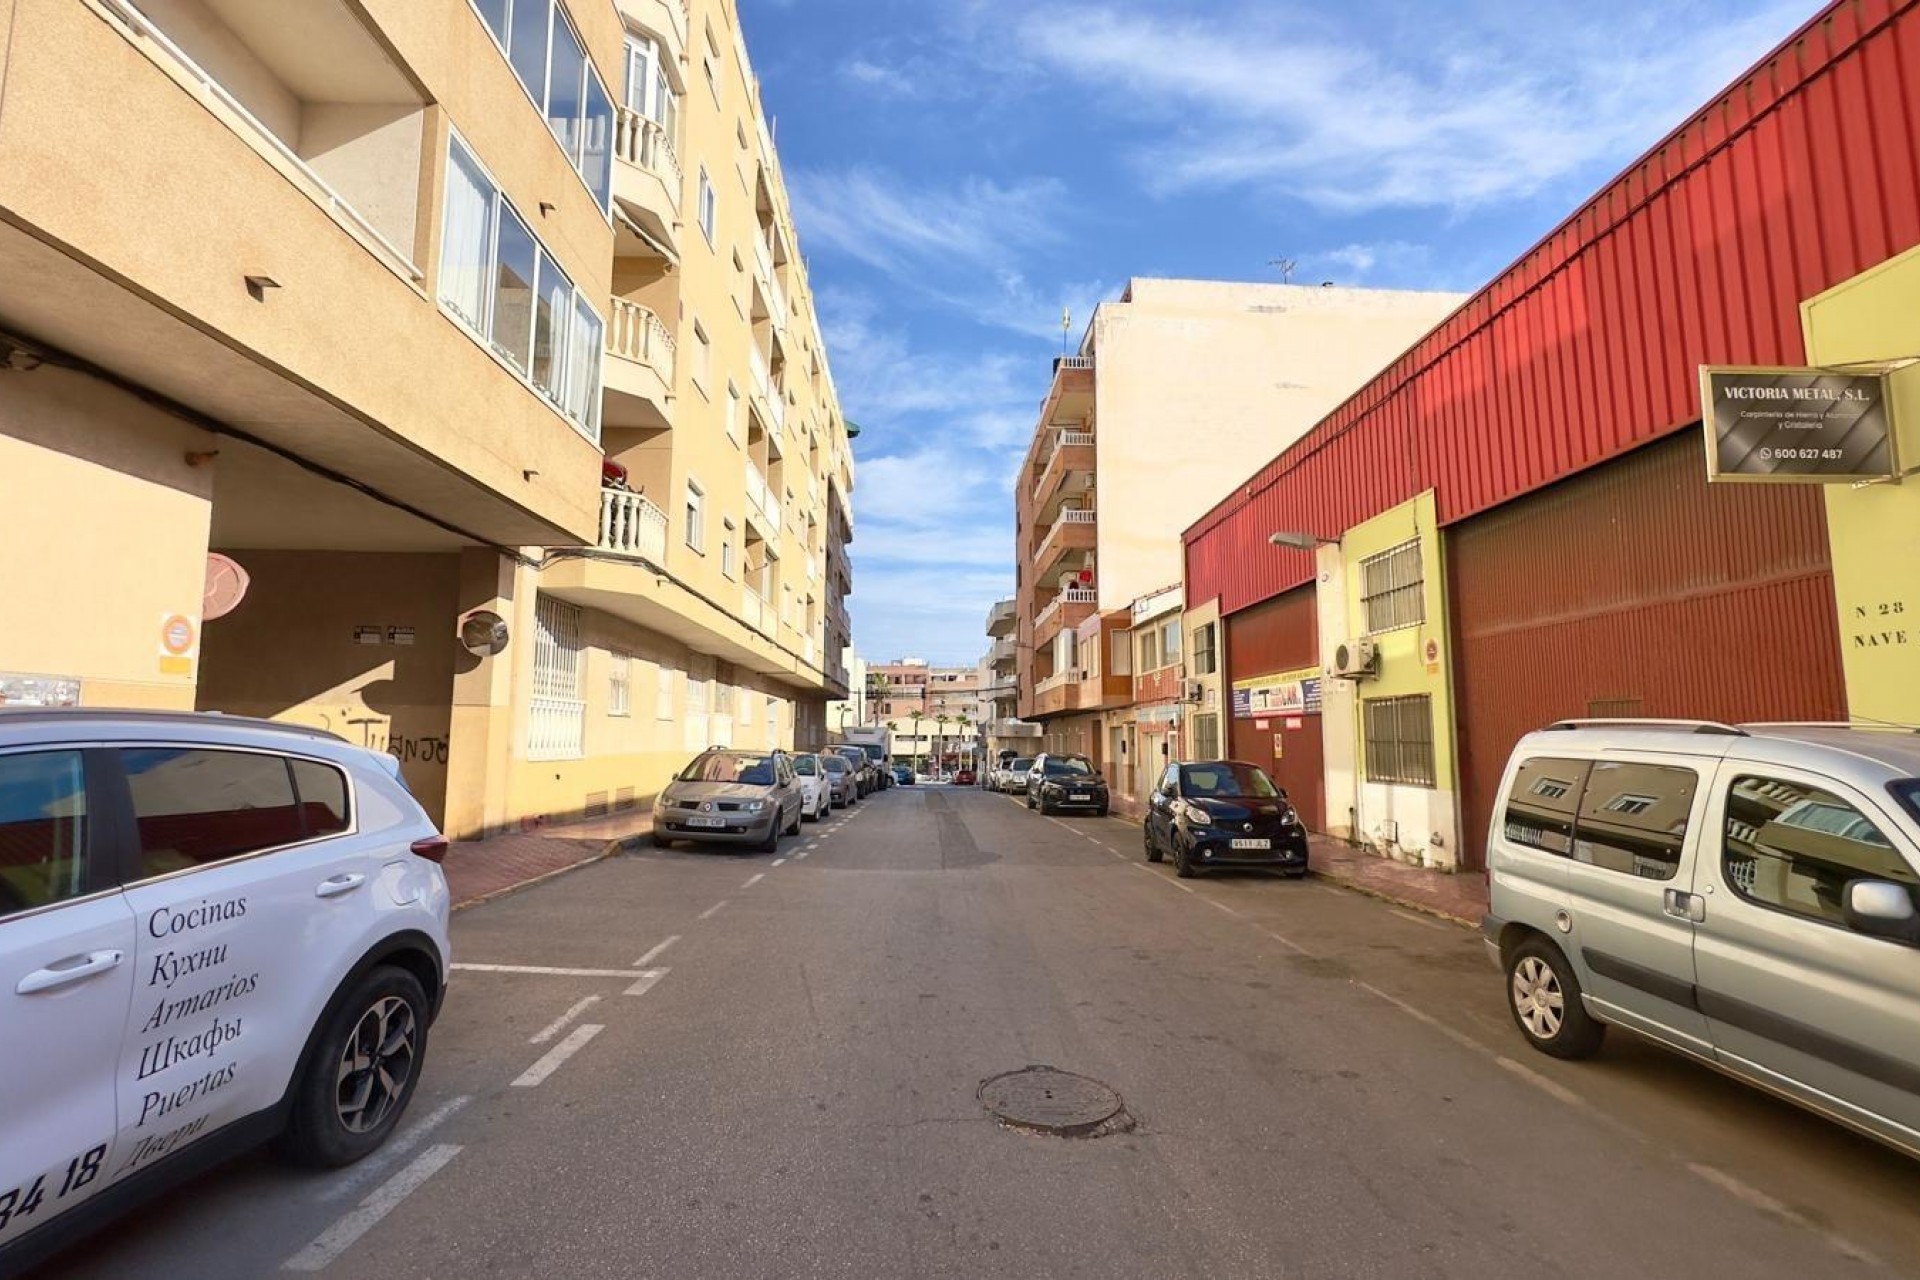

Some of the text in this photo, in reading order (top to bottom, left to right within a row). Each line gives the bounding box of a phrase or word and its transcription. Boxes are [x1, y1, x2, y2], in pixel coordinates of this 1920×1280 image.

[1724, 386, 1870, 401] VICTORIA METAL, S.L.
[1774, 448, 1843, 459] 600 627 487
[1855, 602, 1904, 619] N 28
[1855, 629, 1907, 648] NAVE
[149, 896, 248, 939] Cocinas
[149, 943, 229, 988] Кухни
[142, 972, 260, 1034] Armarios
[136, 1017, 243, 1081] Шкафы
[136, 1061, 238, 1127] Puertas
[112, 1113, 209, 1178] Двери
[57, 1143, 107, 1199] 18
